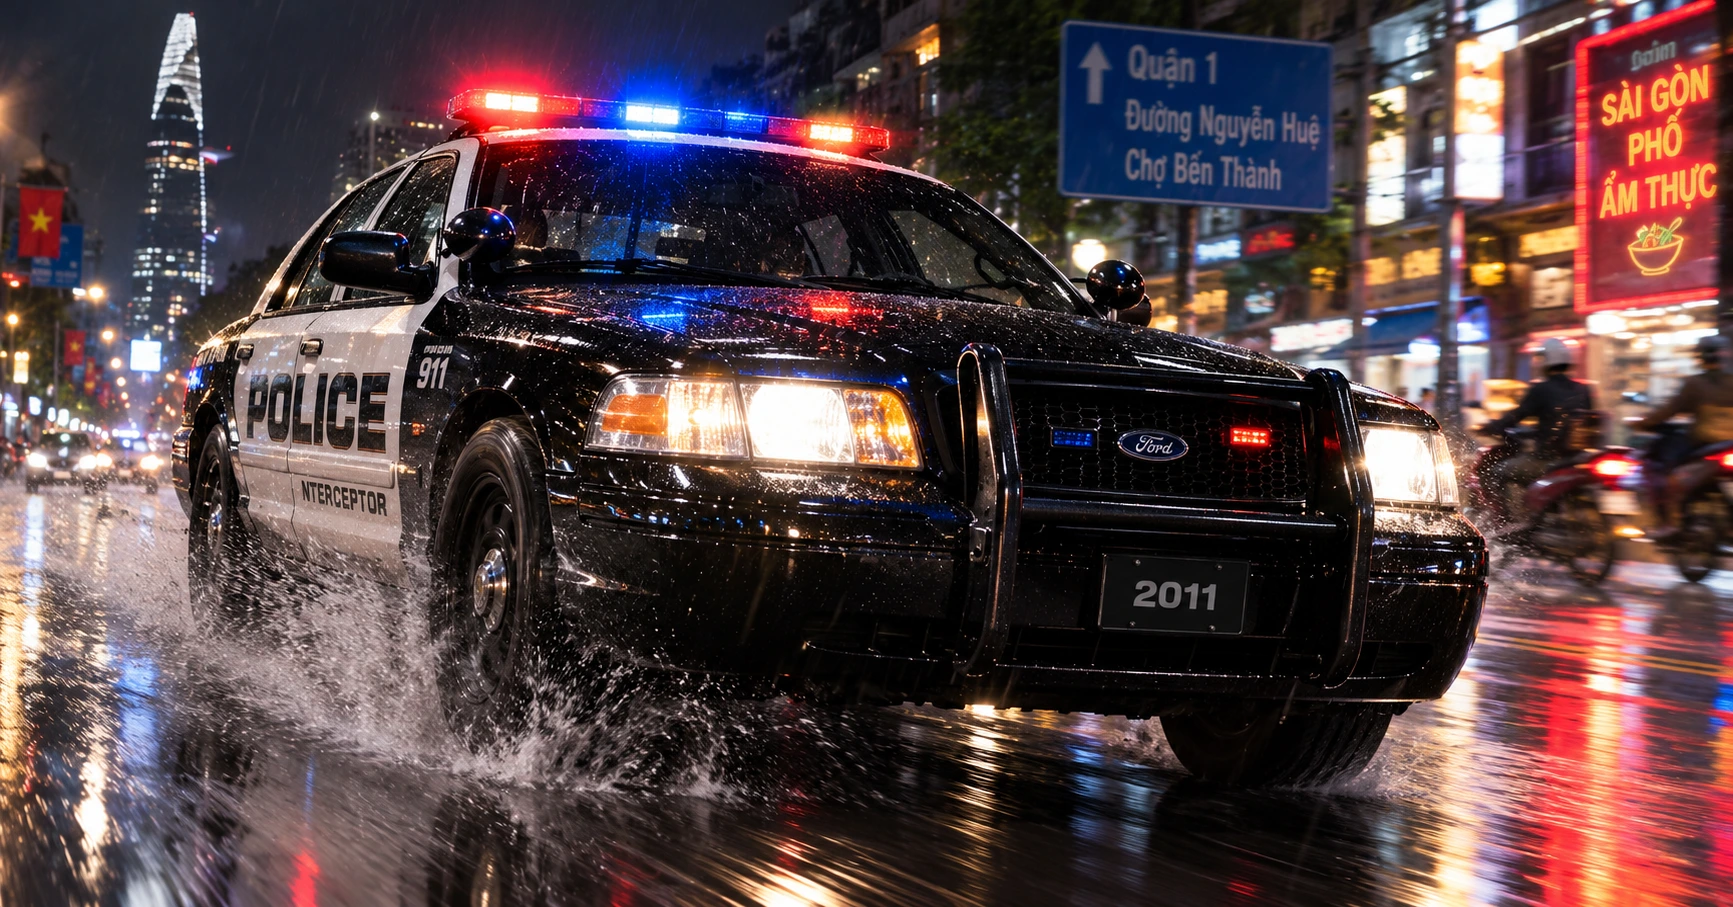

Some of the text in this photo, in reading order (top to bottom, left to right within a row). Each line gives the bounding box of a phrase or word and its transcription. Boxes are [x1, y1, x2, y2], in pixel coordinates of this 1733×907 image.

[1127, 44, 1218, 89] Quận 1
[1601, 64, 1710, 127] SÀI GÒN
[1125, 98, 1321, 151] Đường Nguyễn Huệ
[1628, 108, 1683, 167] PHỐ
[1125, 148, 1282, 190] Chợ Bến Thành
[1599, 163, 1718, 219] ẨM THỰC
[416, 356, 450, 389] 911
[246, 372, 391, 455] POLICE
[1135, 434, 1174, 454] Ford
[301, 480, 388, 517] NTERCEPTOR
[1132, 580, 1217, 611] 2011
